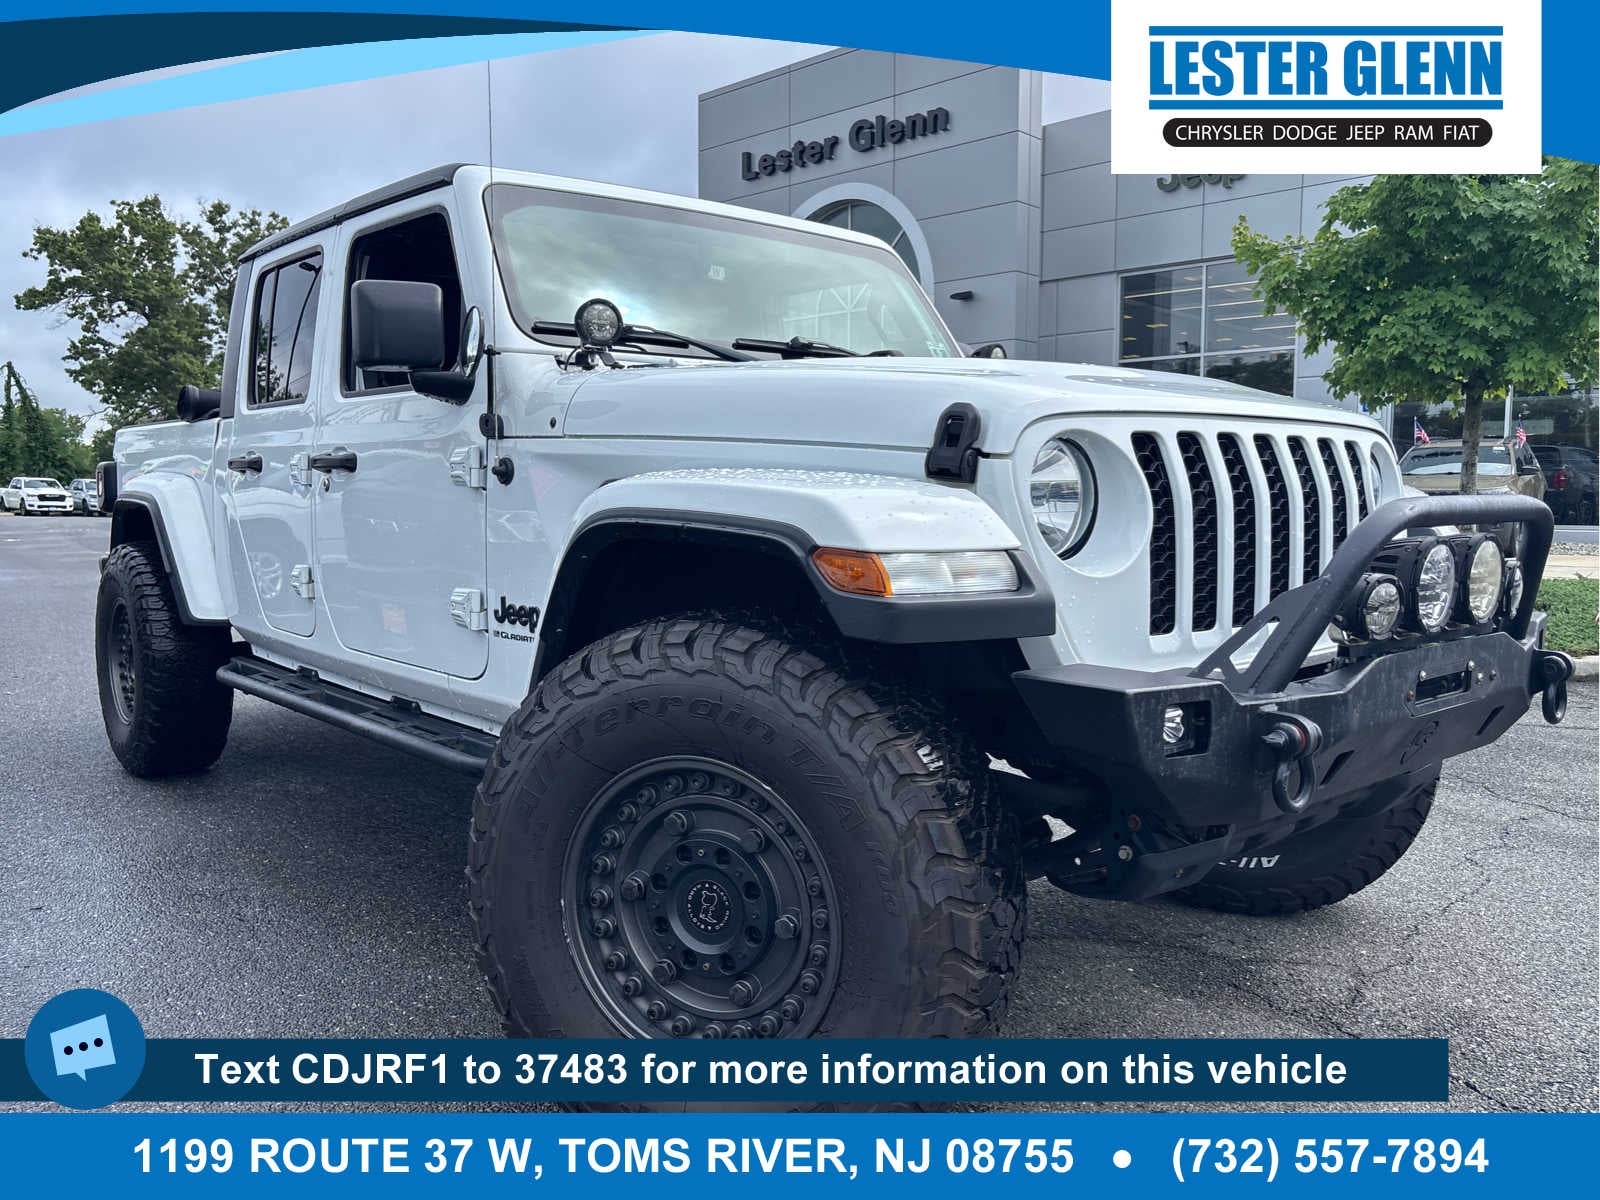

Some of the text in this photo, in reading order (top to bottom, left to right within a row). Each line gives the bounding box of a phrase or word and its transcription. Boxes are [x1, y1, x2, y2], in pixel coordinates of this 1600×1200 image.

[741, 106, 951, 182] Lester Glenn
[493, 596, 541, 633] Jeep
[500, 631, 536, 643] GLADIAT
